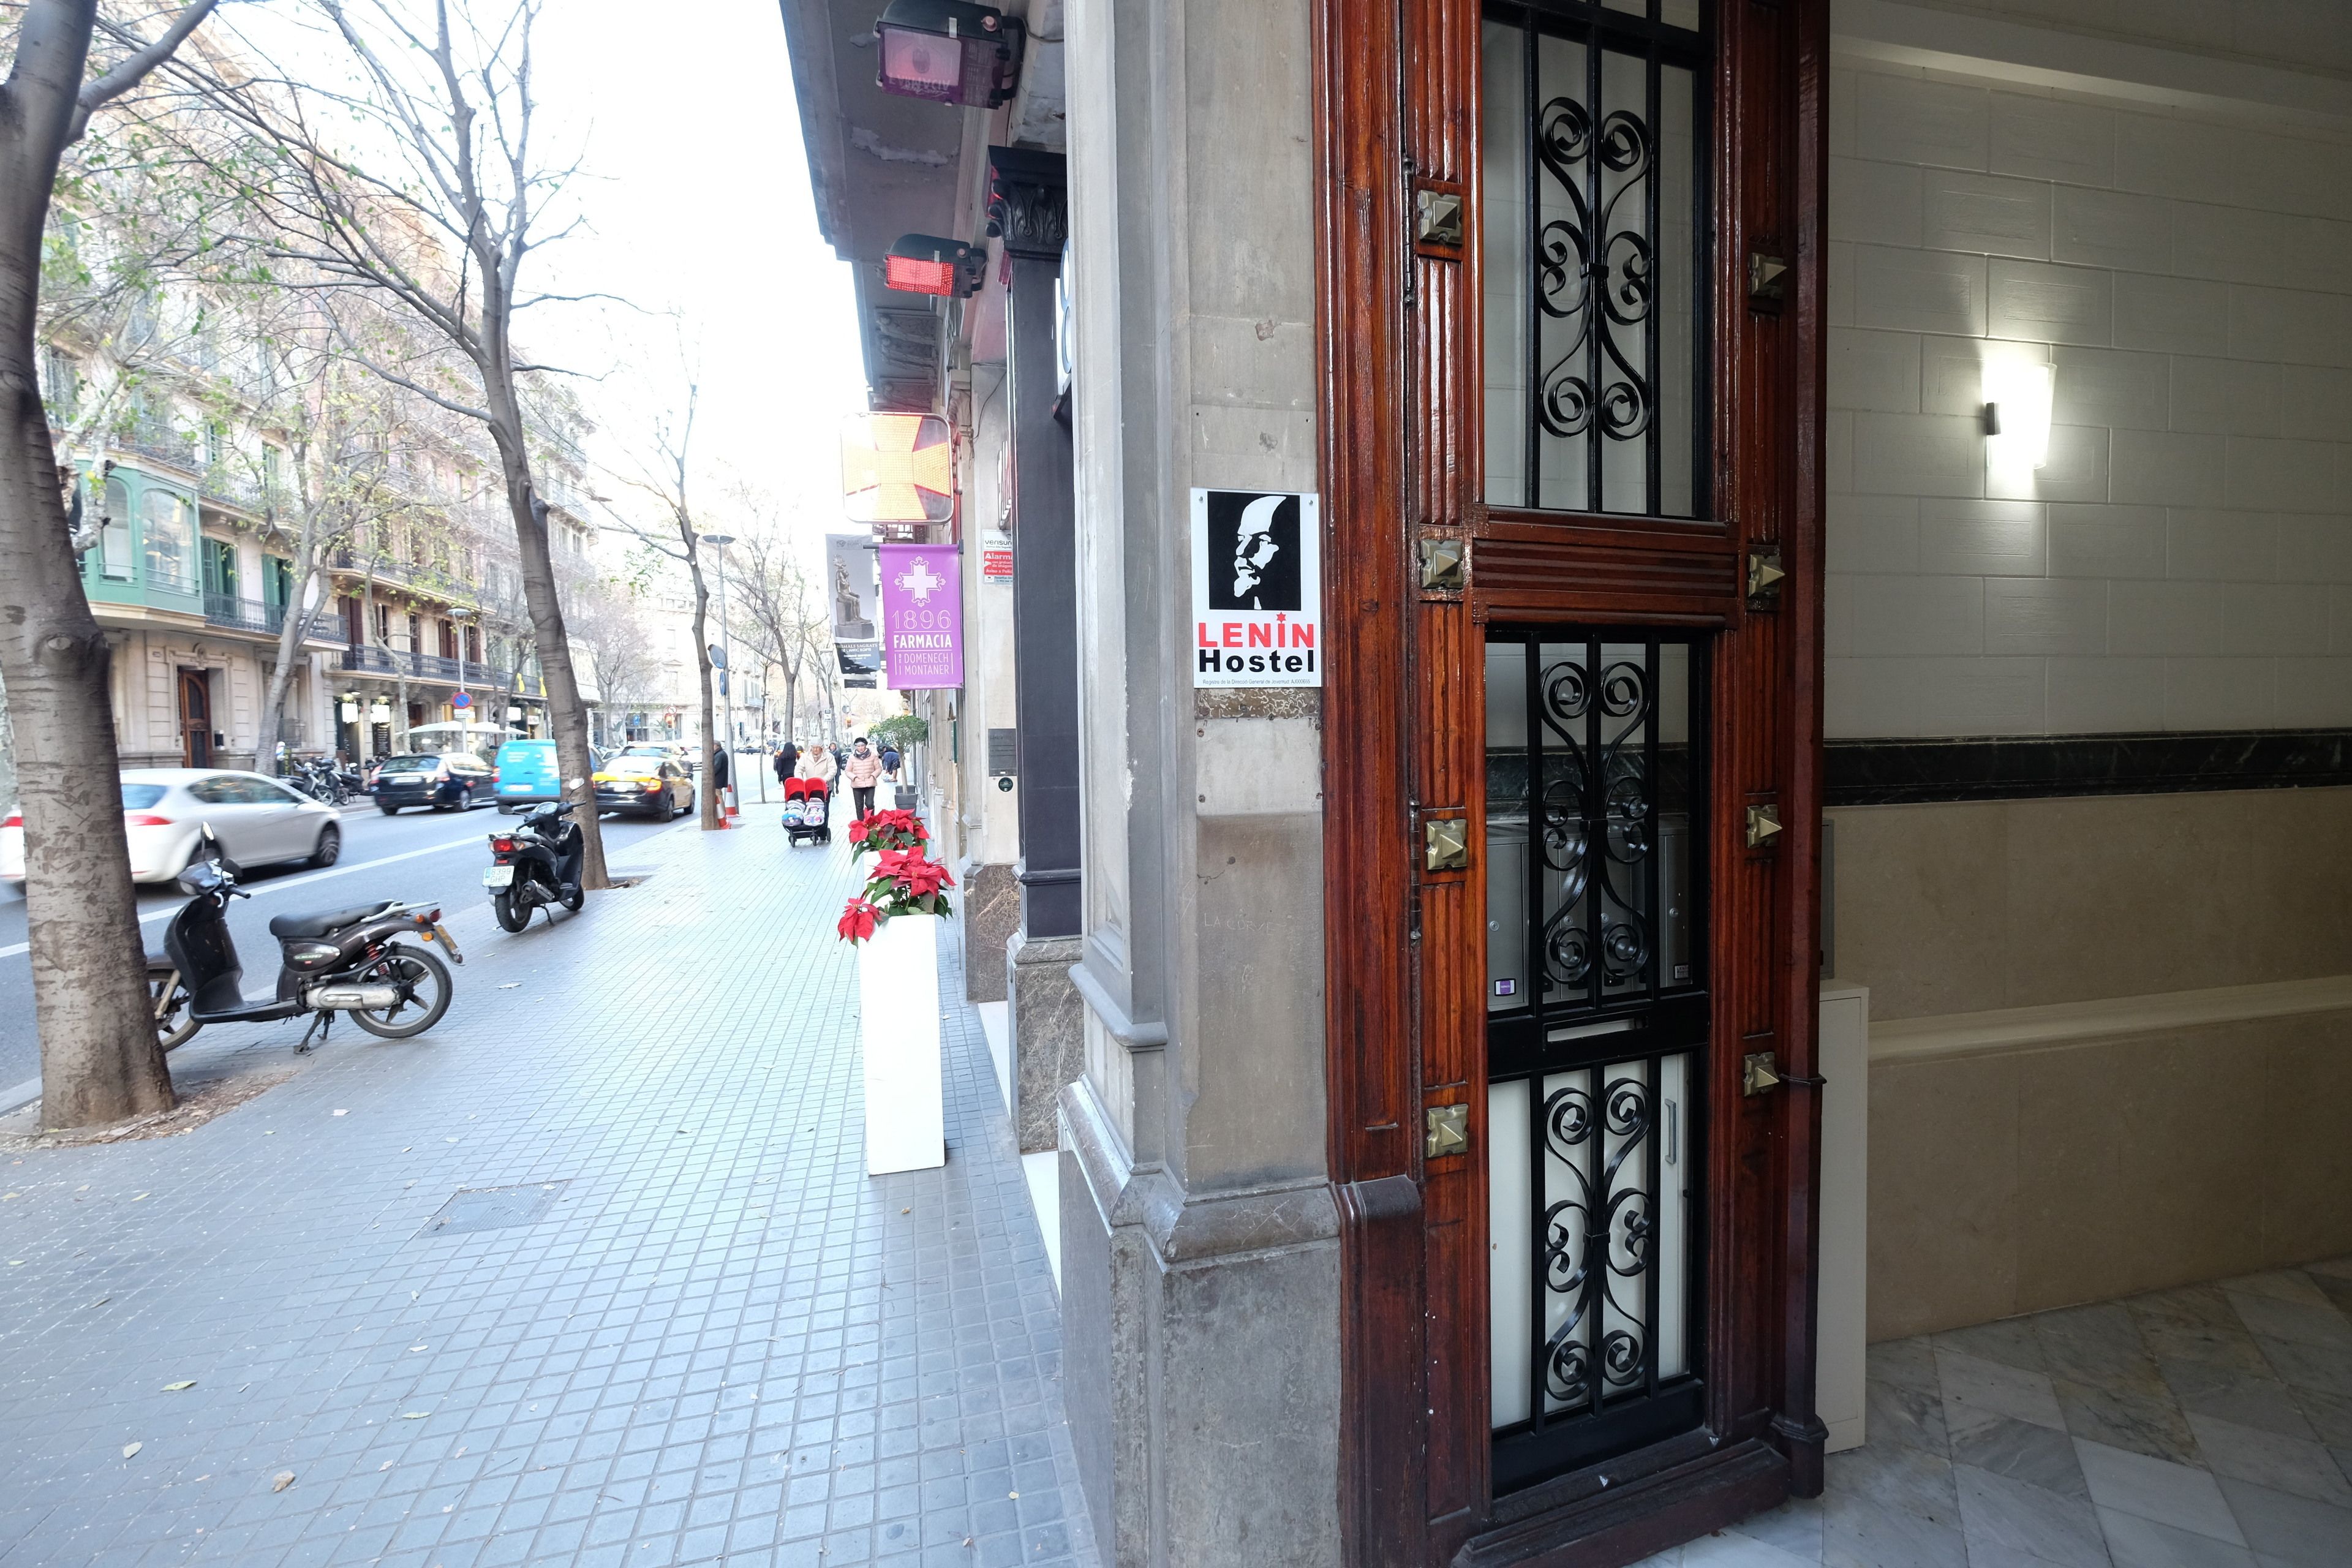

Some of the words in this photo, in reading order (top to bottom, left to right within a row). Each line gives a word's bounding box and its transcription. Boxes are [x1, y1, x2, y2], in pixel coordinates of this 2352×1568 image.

[892, 610, 951, 629] 1896
[1199, 614, 1314, 648] LENIN
[894, 635, 952, 648] FARMACIA
[904, 653, 949, 663] DOMENECH
[1199, 649, 1314, 673] Hostel
[905, 665, 949, 675] MONTANER
